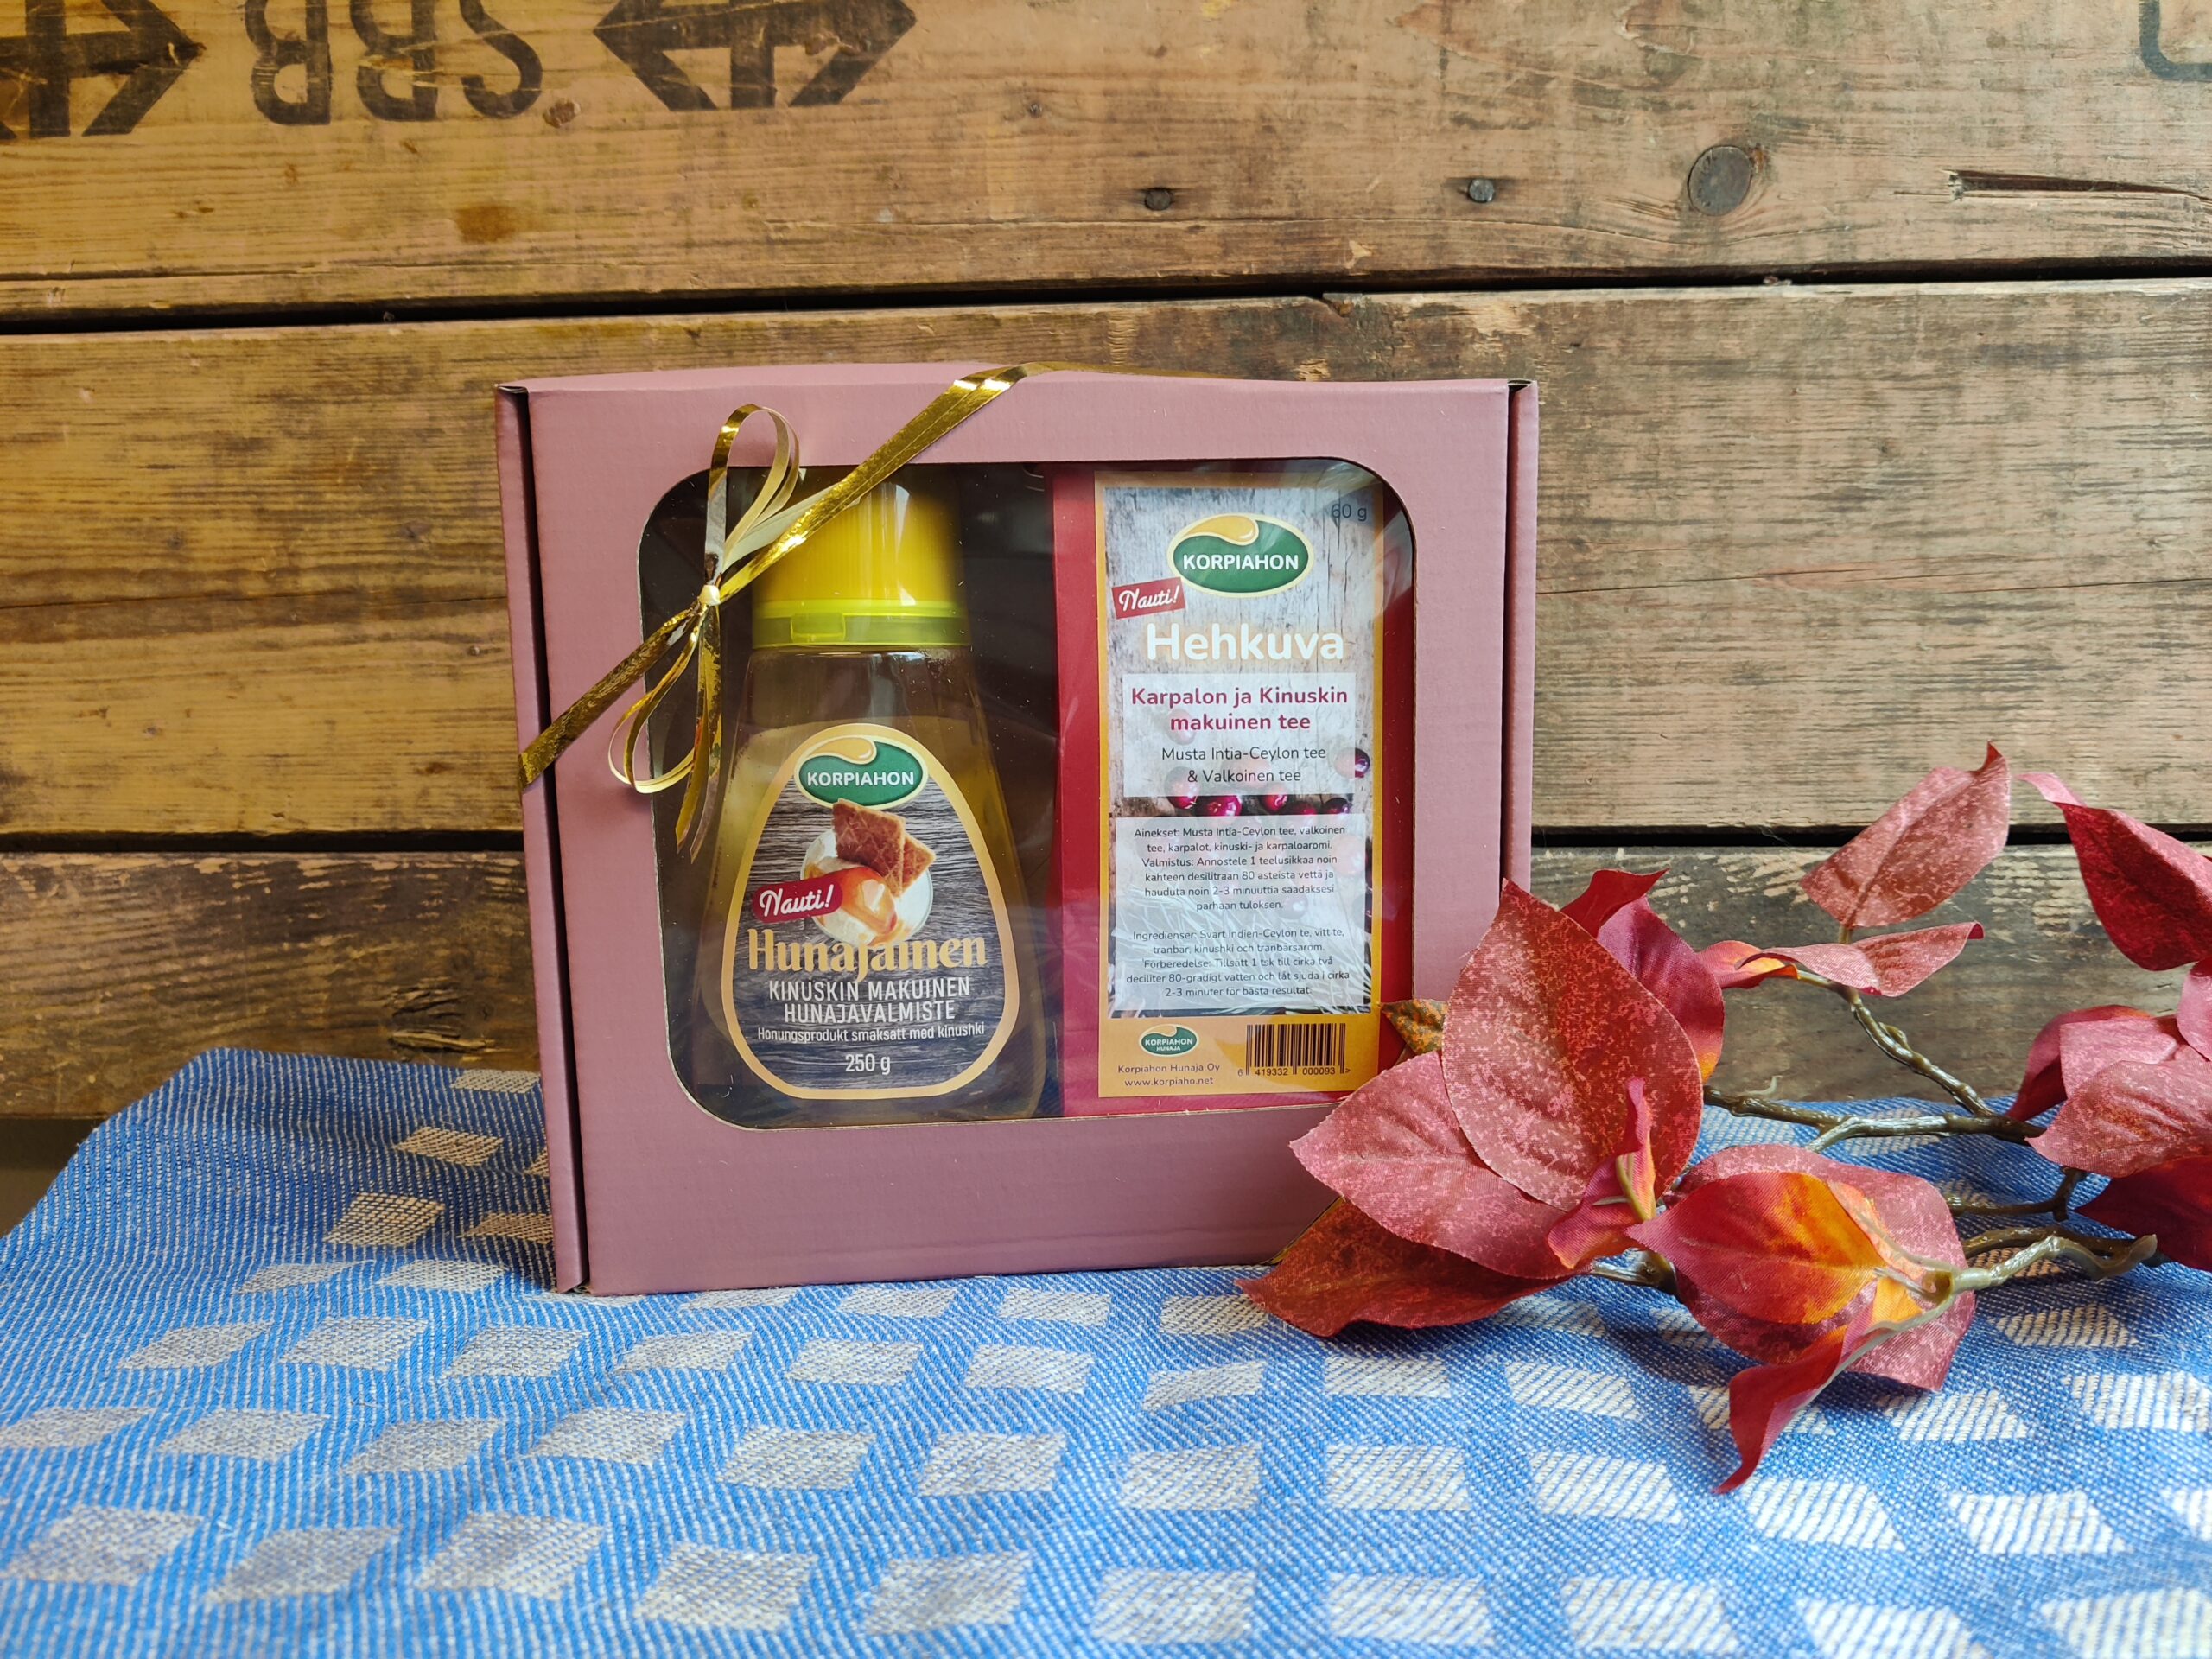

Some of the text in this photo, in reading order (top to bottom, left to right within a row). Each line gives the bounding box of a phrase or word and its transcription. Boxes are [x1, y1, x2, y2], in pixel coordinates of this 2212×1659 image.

[1332, 505, 1367, 520] 60 g
[1184, 554, 1298, 570] KORPIAHON
[1118, 586, 1179, 611] Nauti!
[1147, 624, 1344, 660] Hehkuva
[1132, 688, 1347, 708] Karpalon ja Kinuskin
[1171, 715, 1311, 730] makuinen tee
[1162, 747, 1325, 762] Musta Intia-Ceylon tee
[808, 772, 913, 786] KORPIAHON
[1187, 770, 1301, 782] & Valkoinen tee
[1183, 828, 1212, 836] Musta
[1217, 827, 1275, 837] Intia-Ceylon
[1168, 843, 1211, 853] karpalot,
[1215, 842, 1252, 851] kinuski-
[1255, 842, 1263, 852] ja
[1266, 841, 1332, 851] karpaloaromi.
[1142, 858, 1193, 867] Valmistus:
[1197, 857, 1247, 866] Annostele
[1260, 855, 1313, 865] teelusikkaa
[1317, 855, 1337, 863] noin
[1146, 873, 1185, 881] kahteen
[1188, 872, 1238, 881] desilitraan
[1242, 871, 1255, 880] 80
[1325, 870, 1333, 880] ja
[1145, 887, 1185, 896] hauduta
[1213, 887, 1229, 895] 2-3
[1233, 886, 1278, 894] minuuttia
[1282, 884, 1334, 893] saadaksesi
[760, 885, 834, 917] Nauti!
[1197, 900, 1283, 911] parhaan tuloksen.
[1200, 930, 1226, 938] Svart
[1229, 929, 1296, 938] Indien-Ceylon
[1315, 928, 1332, 937] vitt
[747, 928, 988, 982] Hunajainen
[1194, 944, 1234, 953] kinushki
[1237, 944, 1254, 952] och
[1278, 957, 1290, 966] till
[1294, 957, 1315, 965] cirka
[1319, 956, 1333, 965] två
[1169, 974, 1221, 983] 80-gradigt
[1294, 971, 1319, 982] sjuda
[769, 976, 969, 1001] KINUSKIN MAKUINEN
[785, 1000, 956, 1023] HUNAJAVALMISTE
[759, 1022, 984, 1043] Honungsprodukt smaksatt med kinushki
[845, 1054, 890, 1074] 250 g
[1118, 1065, 1166, 1074] Korpiahon
[1207, 1063, 1220, 1072] Oy
[1125, 1077, 1213, 1087] www.korpiaho.net
